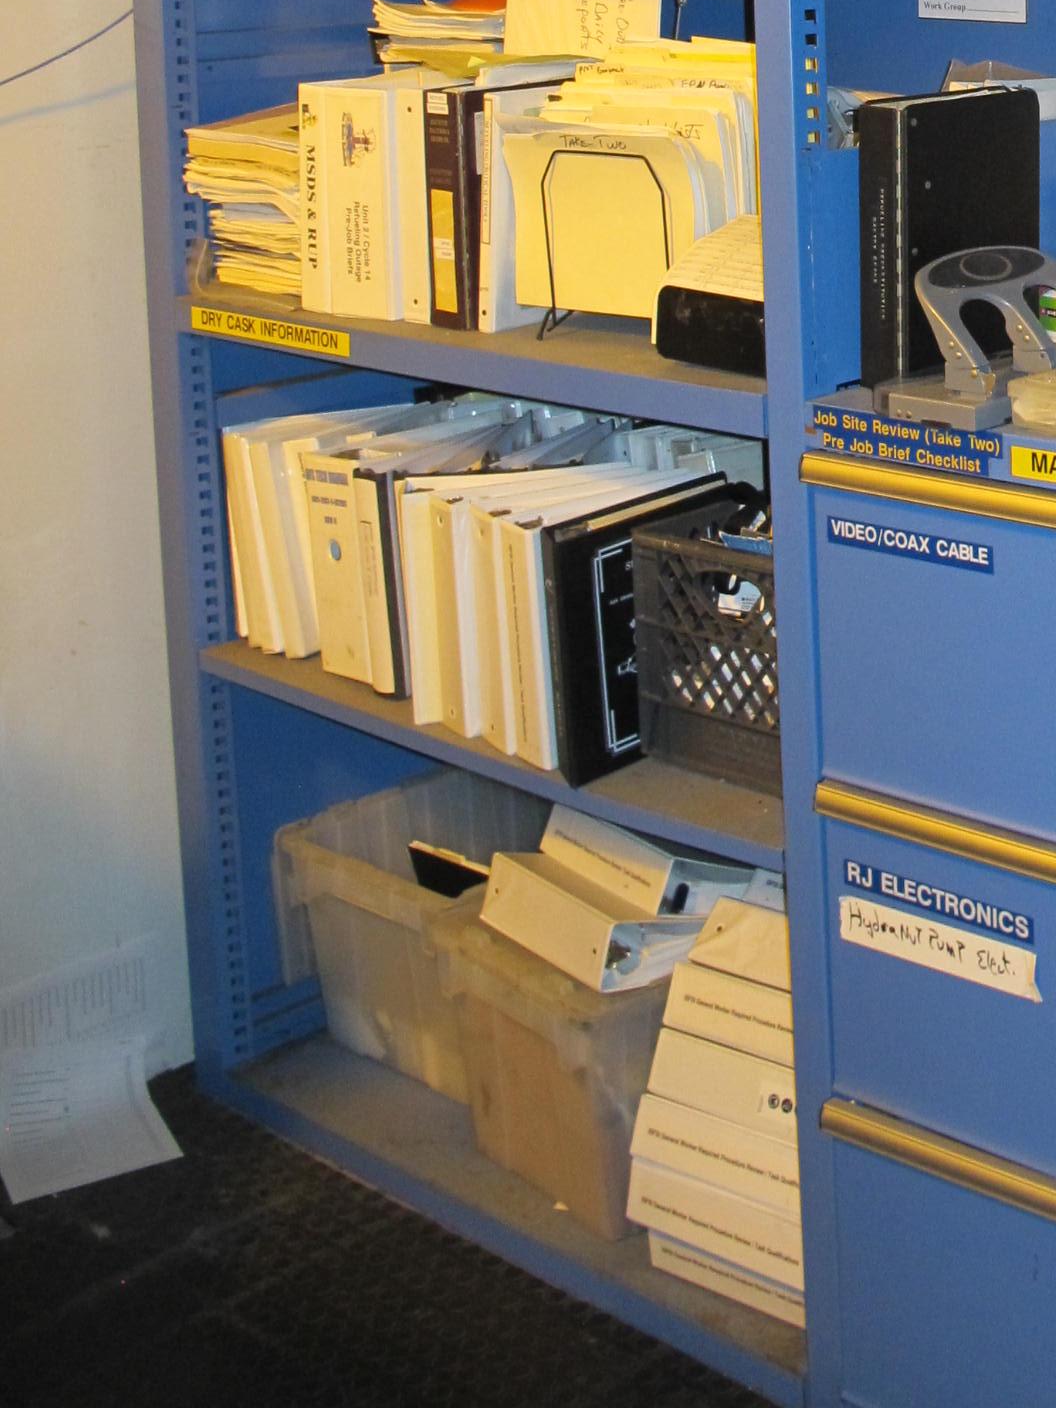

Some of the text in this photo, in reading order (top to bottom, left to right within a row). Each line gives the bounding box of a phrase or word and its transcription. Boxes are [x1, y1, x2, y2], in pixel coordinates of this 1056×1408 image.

[923, 1, 966, 13] Work Group
[305, 144, 318, 270] MSDS & RUP
[353, 201, 361, 246] Refueling
[363, 240, 371, 268] Cycle
[365, 271, 371, 281] 14
[201, 310, 338, 350] DRY CASK INFORMATION
[814, 410, 1001, 456] Job Site Review (Take Two)
[823, 432, 981, 474] Pre Job Brief Checklist
[830, 519, 990, 565] VIDEO/COAX CABLE
[847, 861, 1030, 939] RJ ELECTRONICS
